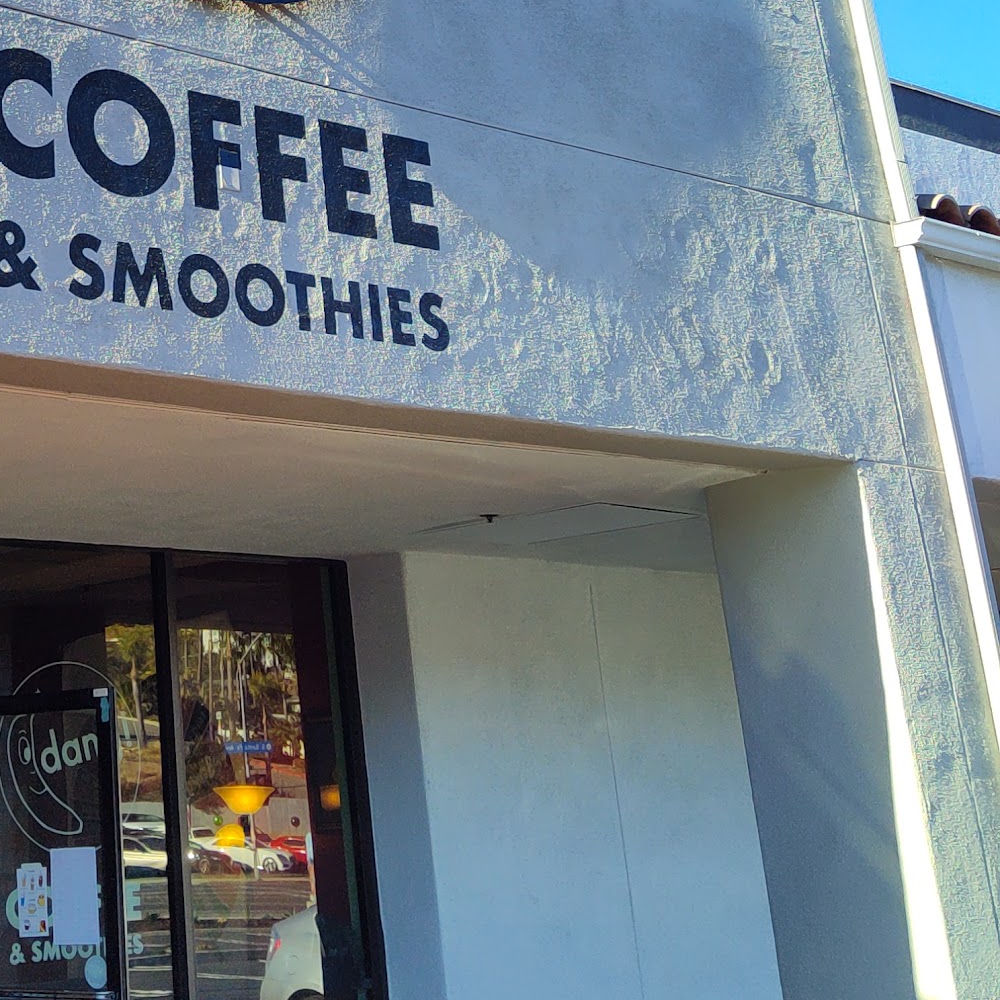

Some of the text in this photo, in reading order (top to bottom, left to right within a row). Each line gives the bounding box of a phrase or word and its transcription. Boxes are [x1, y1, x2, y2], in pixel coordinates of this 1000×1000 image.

[68, 233, 451, 351] SMOOTHIES
[41, 711, 132, 774] dan!
[10, 942, 26, 965] &
